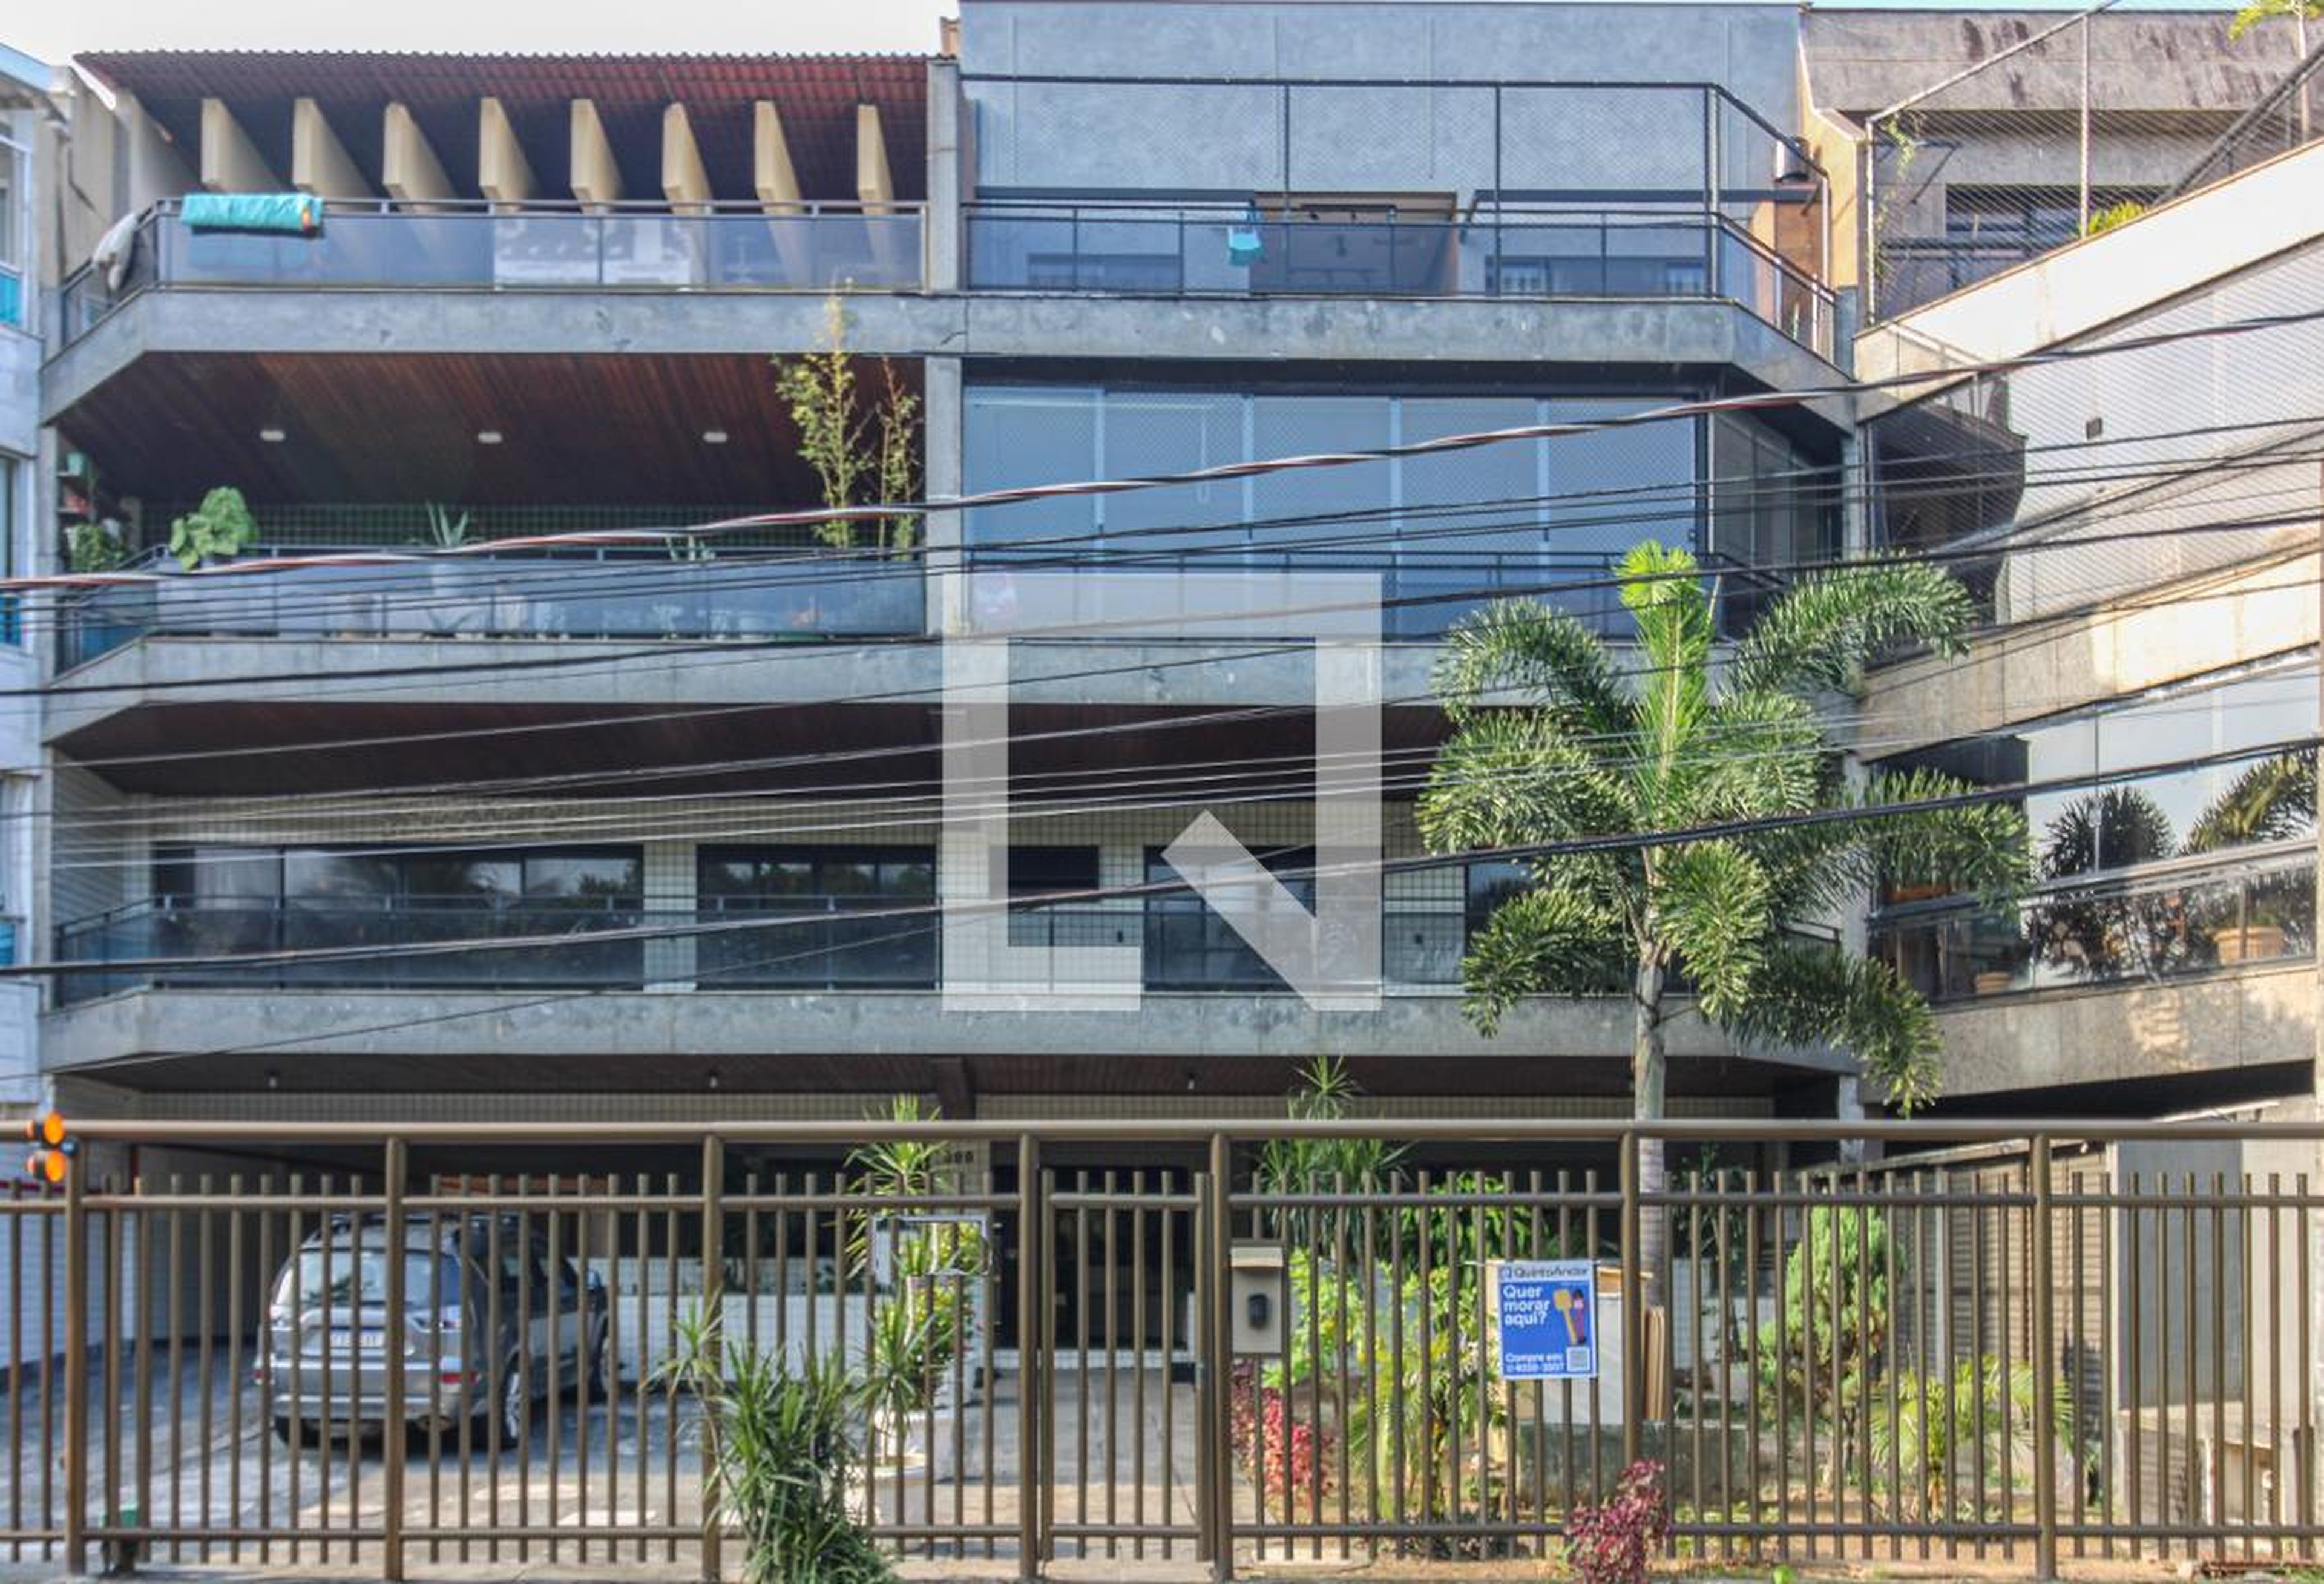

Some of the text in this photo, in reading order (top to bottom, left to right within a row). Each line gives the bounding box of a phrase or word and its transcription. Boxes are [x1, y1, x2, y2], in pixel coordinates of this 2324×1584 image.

[1514, 1266, 1588, 1278] QuintoAndar
[1503, 1284, 1543, 1300] Quer
[1505, 1300, 1550, 1312] morar
[1505, 1311, 1547, 1328] aqui?
